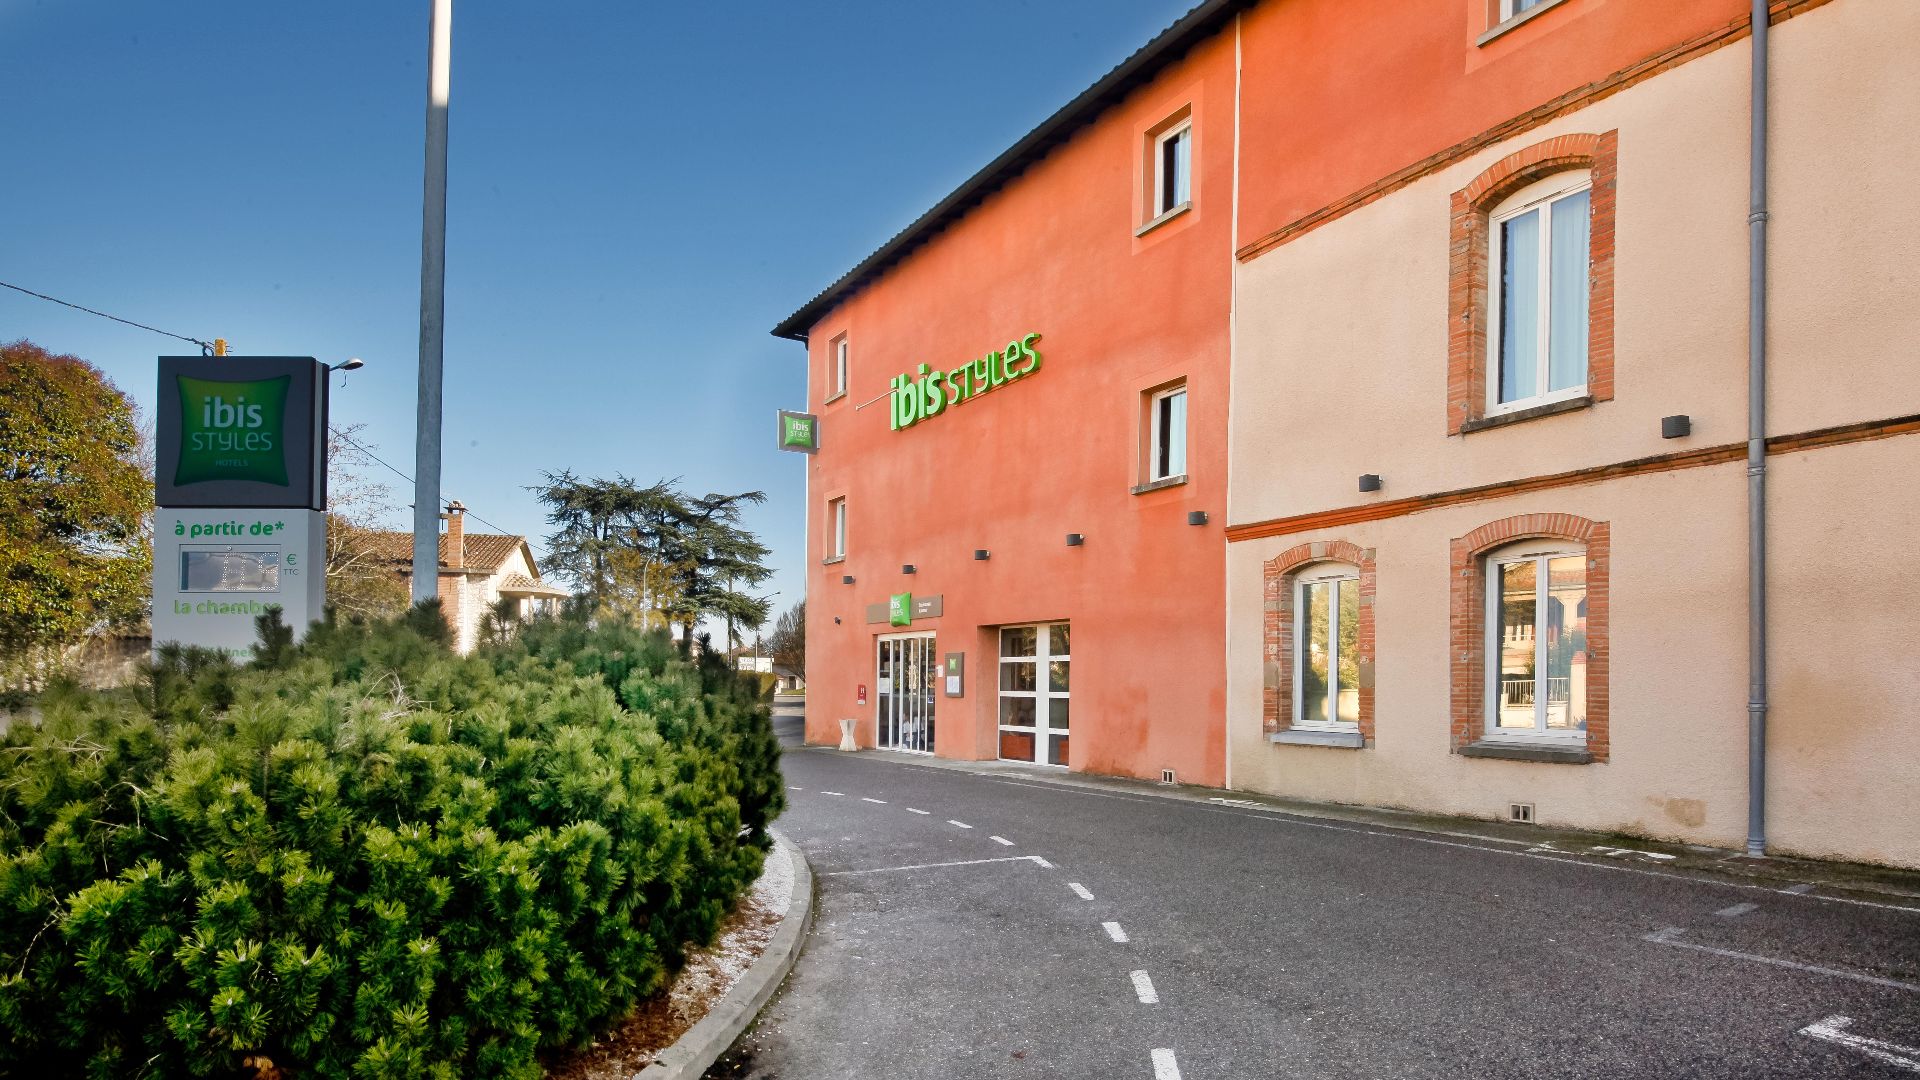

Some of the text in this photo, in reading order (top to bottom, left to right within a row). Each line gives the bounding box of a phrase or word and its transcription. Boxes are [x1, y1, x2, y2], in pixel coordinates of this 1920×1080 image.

[890, 362, 947, 431] ibis
[203, 396, 263, 428] ibis
[792, 420, 809, 431] ibis
[215, 459, 249, 467] HOTELS
[174, 519, 186, 536] à
[190, 520, 245, 539] partir
[286, 553, 297, 566] €
[283, 568, 300, 576] TTC
[174, 599, 191, 615] la
